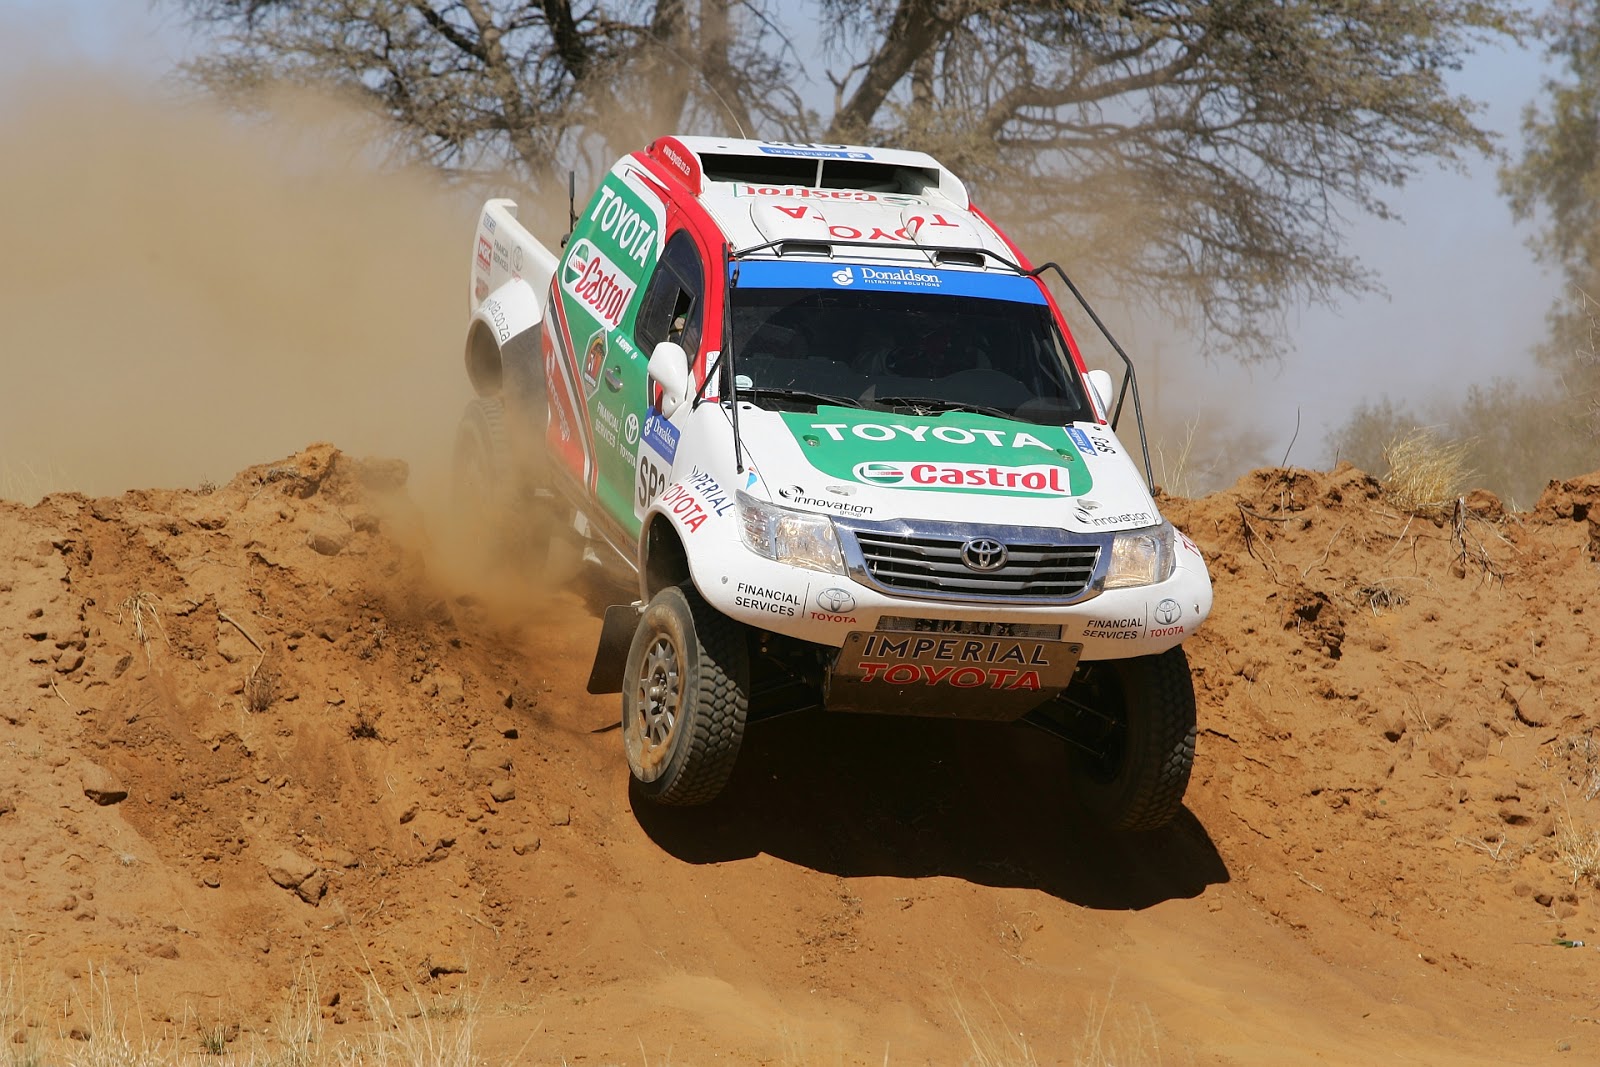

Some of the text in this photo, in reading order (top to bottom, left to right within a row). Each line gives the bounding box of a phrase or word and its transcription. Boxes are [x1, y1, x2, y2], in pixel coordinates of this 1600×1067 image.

[590, 184, 658, 268] TOYOTA
[574, 256, 632, 327] Castrol
[596, 401, 620, 433] FINANCIAL
[653, 417, 677, 449] Donaldson
[811, 423, 1054, 451] TOYOTA
[619, 443, 637, 470] TOYOTA
[683, 464, 735, 518] IMPERIAL
[911, 463, 1065, 493] Castrol
[793, 496, 873, 514] innovation
[840, 510, 862, 518] group
[1091, 511, 1152, 527] innovation
[734, 596, 795, 617] SERVICES
[737, 582, 801, 607] FINANCIAL
[810, 611, 857, 624] TOYOTA
[1086, 617, 1143, 629] FINANCIAL
[1082, 629, 1138, 640] SERVICES
[1149, 625, 1185, 638] TOYOTA
[862, 634, 1051, 667] IMPERIAL
[857, 662, 1043, 692] TOYOTA
